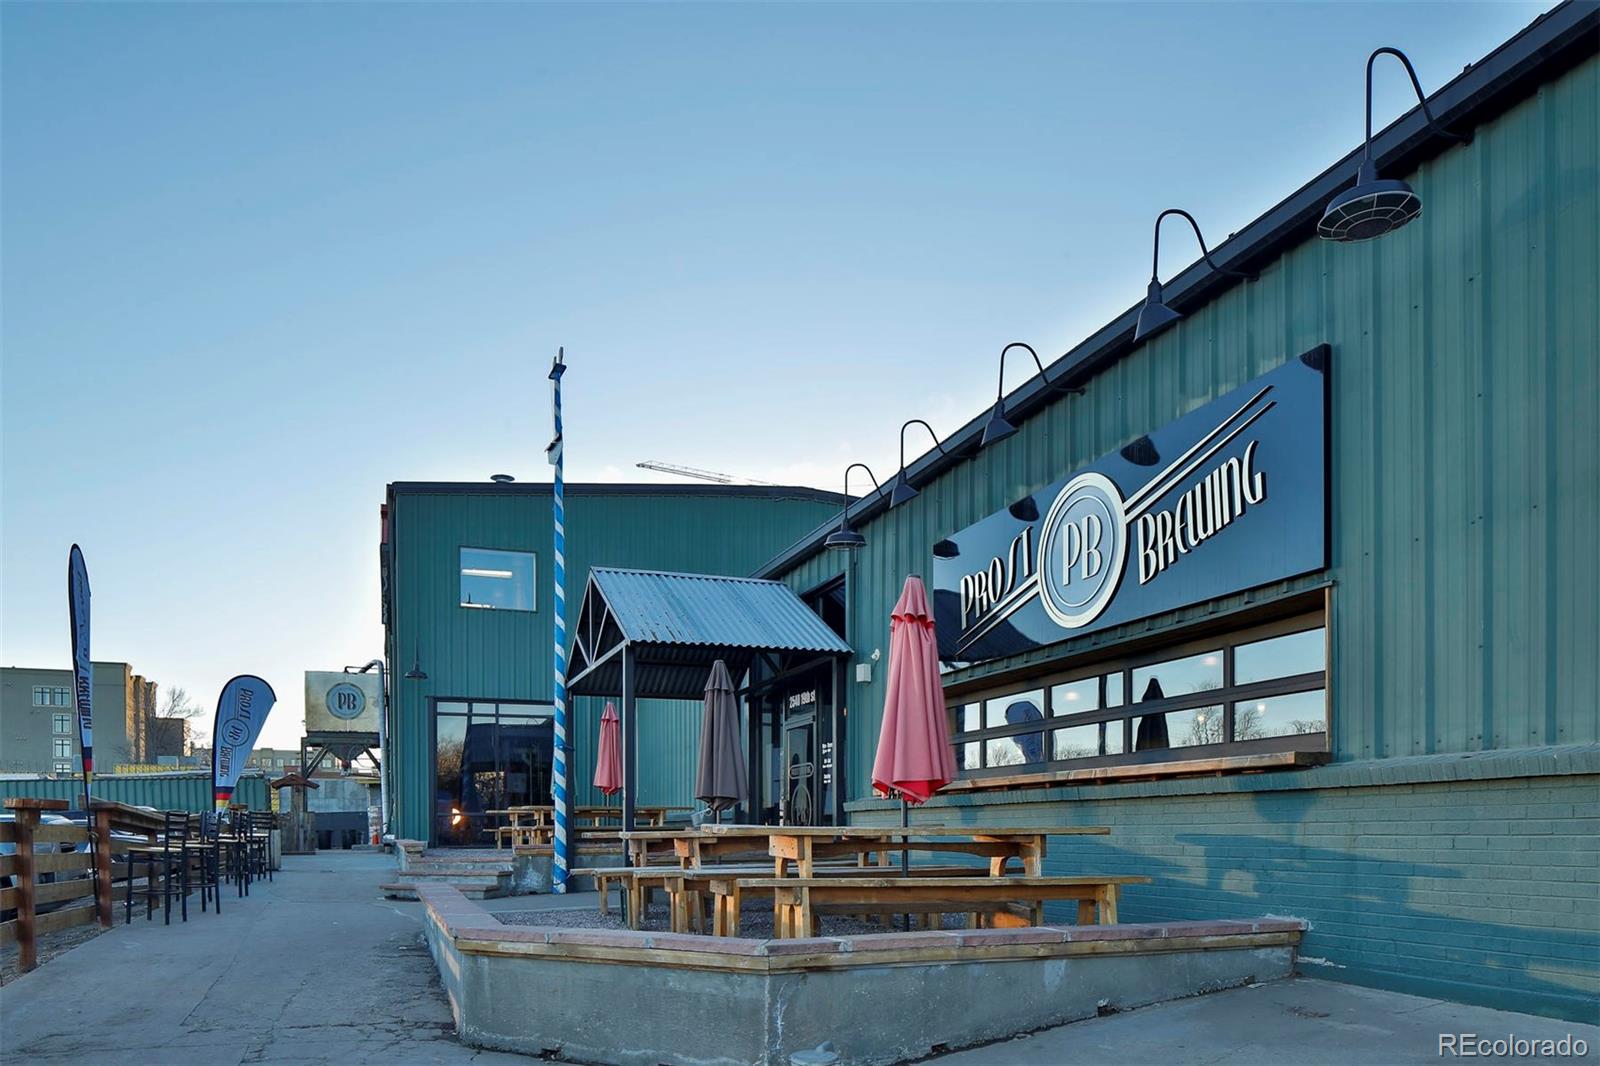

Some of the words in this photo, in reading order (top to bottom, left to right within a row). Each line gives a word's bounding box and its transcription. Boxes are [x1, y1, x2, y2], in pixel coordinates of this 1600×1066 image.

[960, 526, 1033, 629] PROST
[1062, 513, 1102, 586] PB
[1137, 440, 1266, 585] BREWING
[240, 687, 254, 720] PROST
[337, 692, 357, 710] PB
[220, 745, 234, 777] BREWING
